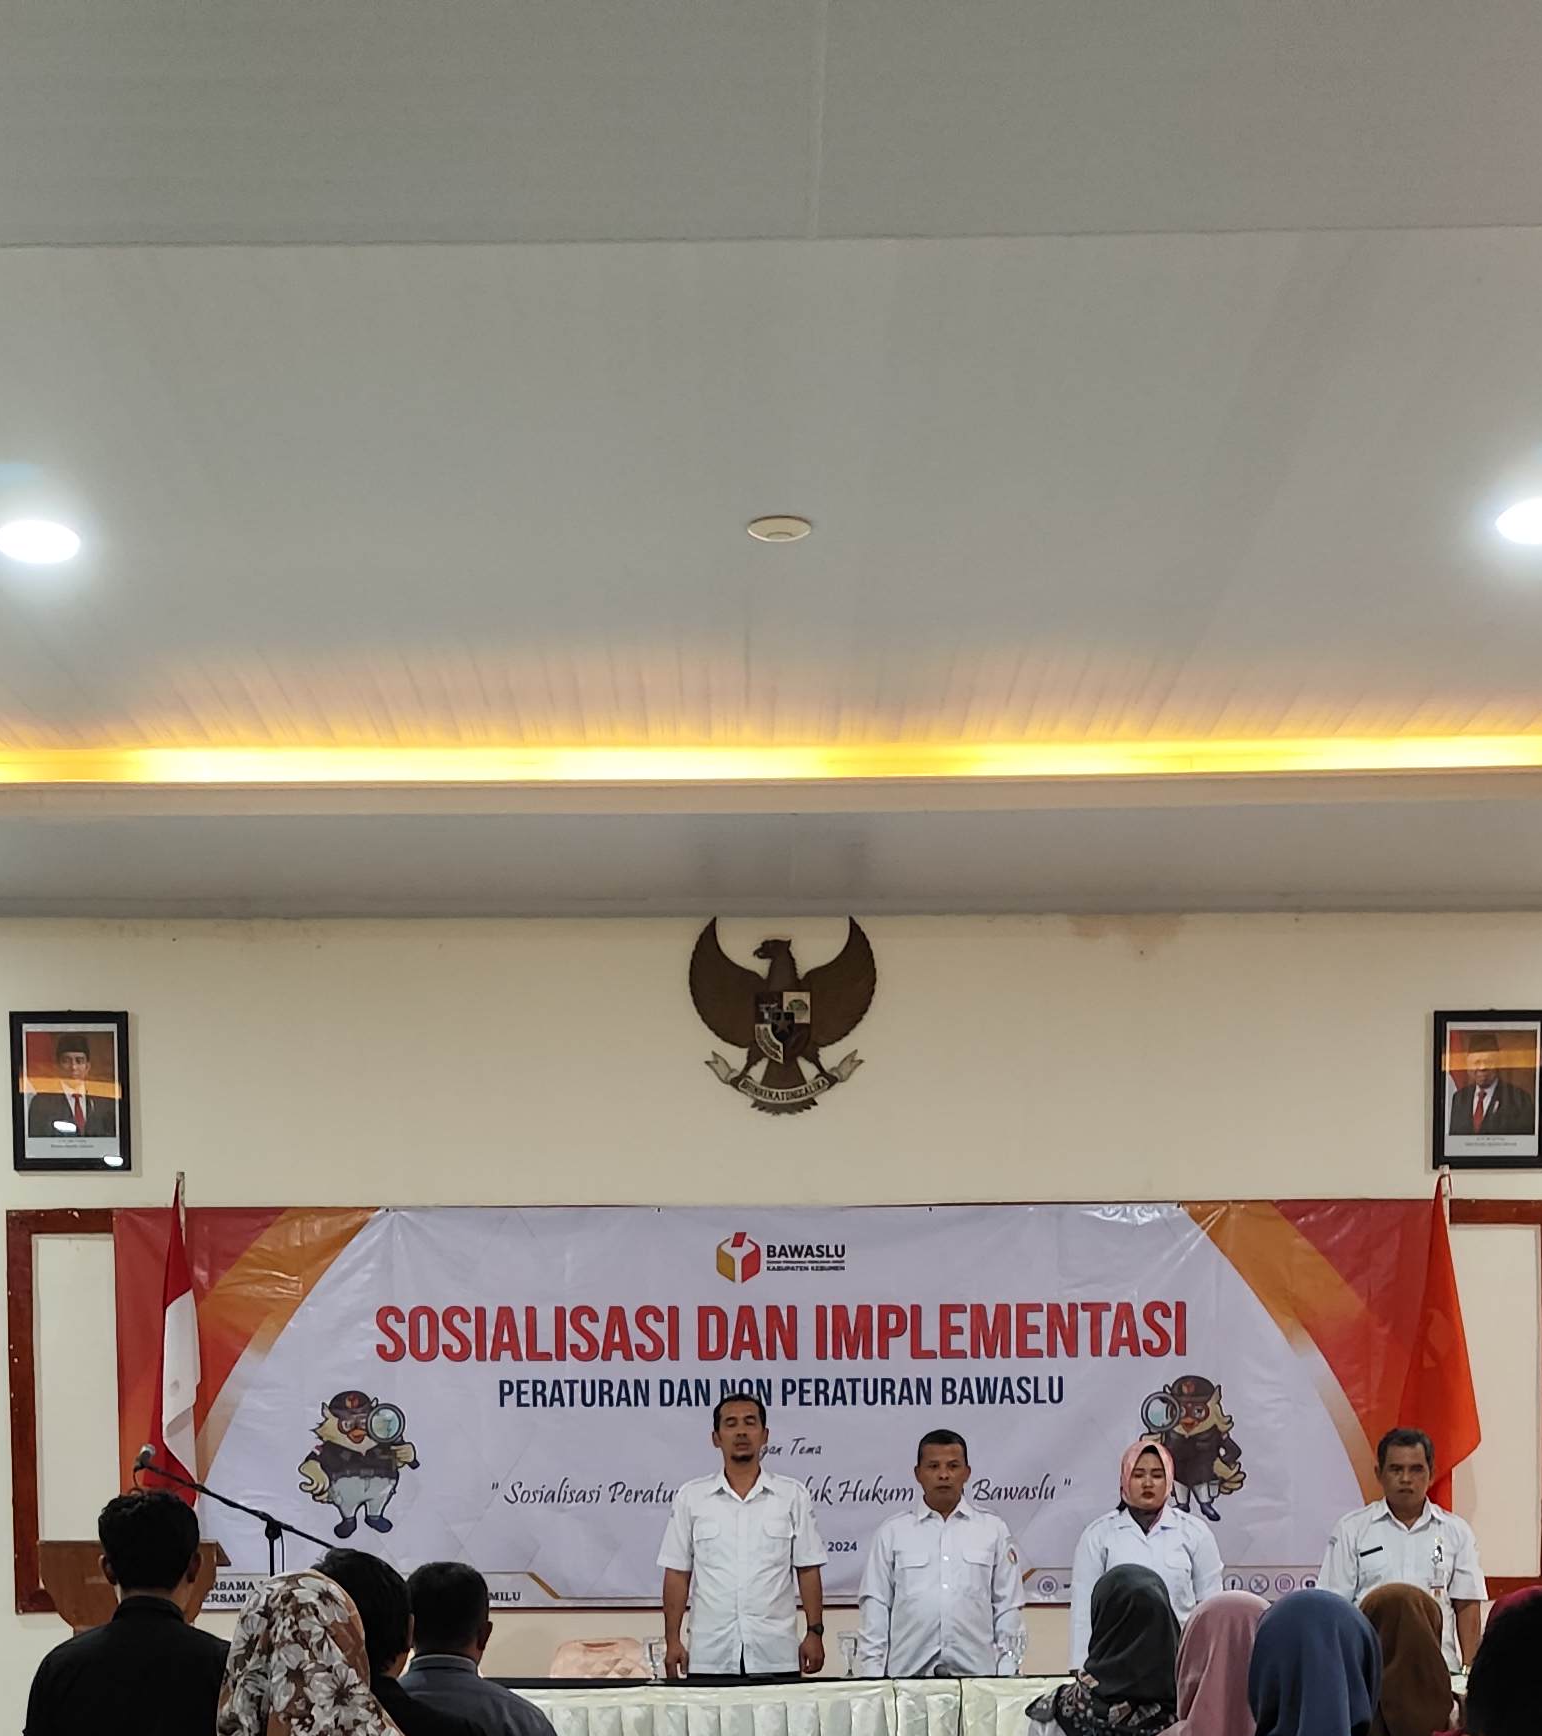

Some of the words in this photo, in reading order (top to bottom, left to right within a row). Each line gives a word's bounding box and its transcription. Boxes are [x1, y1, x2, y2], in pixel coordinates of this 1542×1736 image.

[766, 1244, 846, 1258] BAWASLU
[375, 1304, 680, 1362] SOSIALISASI
[697, 1304, 798, 1361] DAN
[815, 1301, 1187, 1360] IMPLEMENTASI
[499, 1379, 650, 1407] PERATURAN
[659, 1378, 711, 1407] DAN
[781, 1377, 932, 1406] PERATURAN
[941, 1375, 1064, 1405] BAWASLU
[790, 1437, 822, 1456] Tema
[503, 1477, 602, 1505] Sosialisasi
[608, 1480, 680, 1505] Peratu
[839, 1475, 915, 1505] Hukum
[972, 1473, 1056, 1502] Bawaslu
[827, 1541, 858, 1552] 2024
[488, 1591, 522, 1601] MILU
